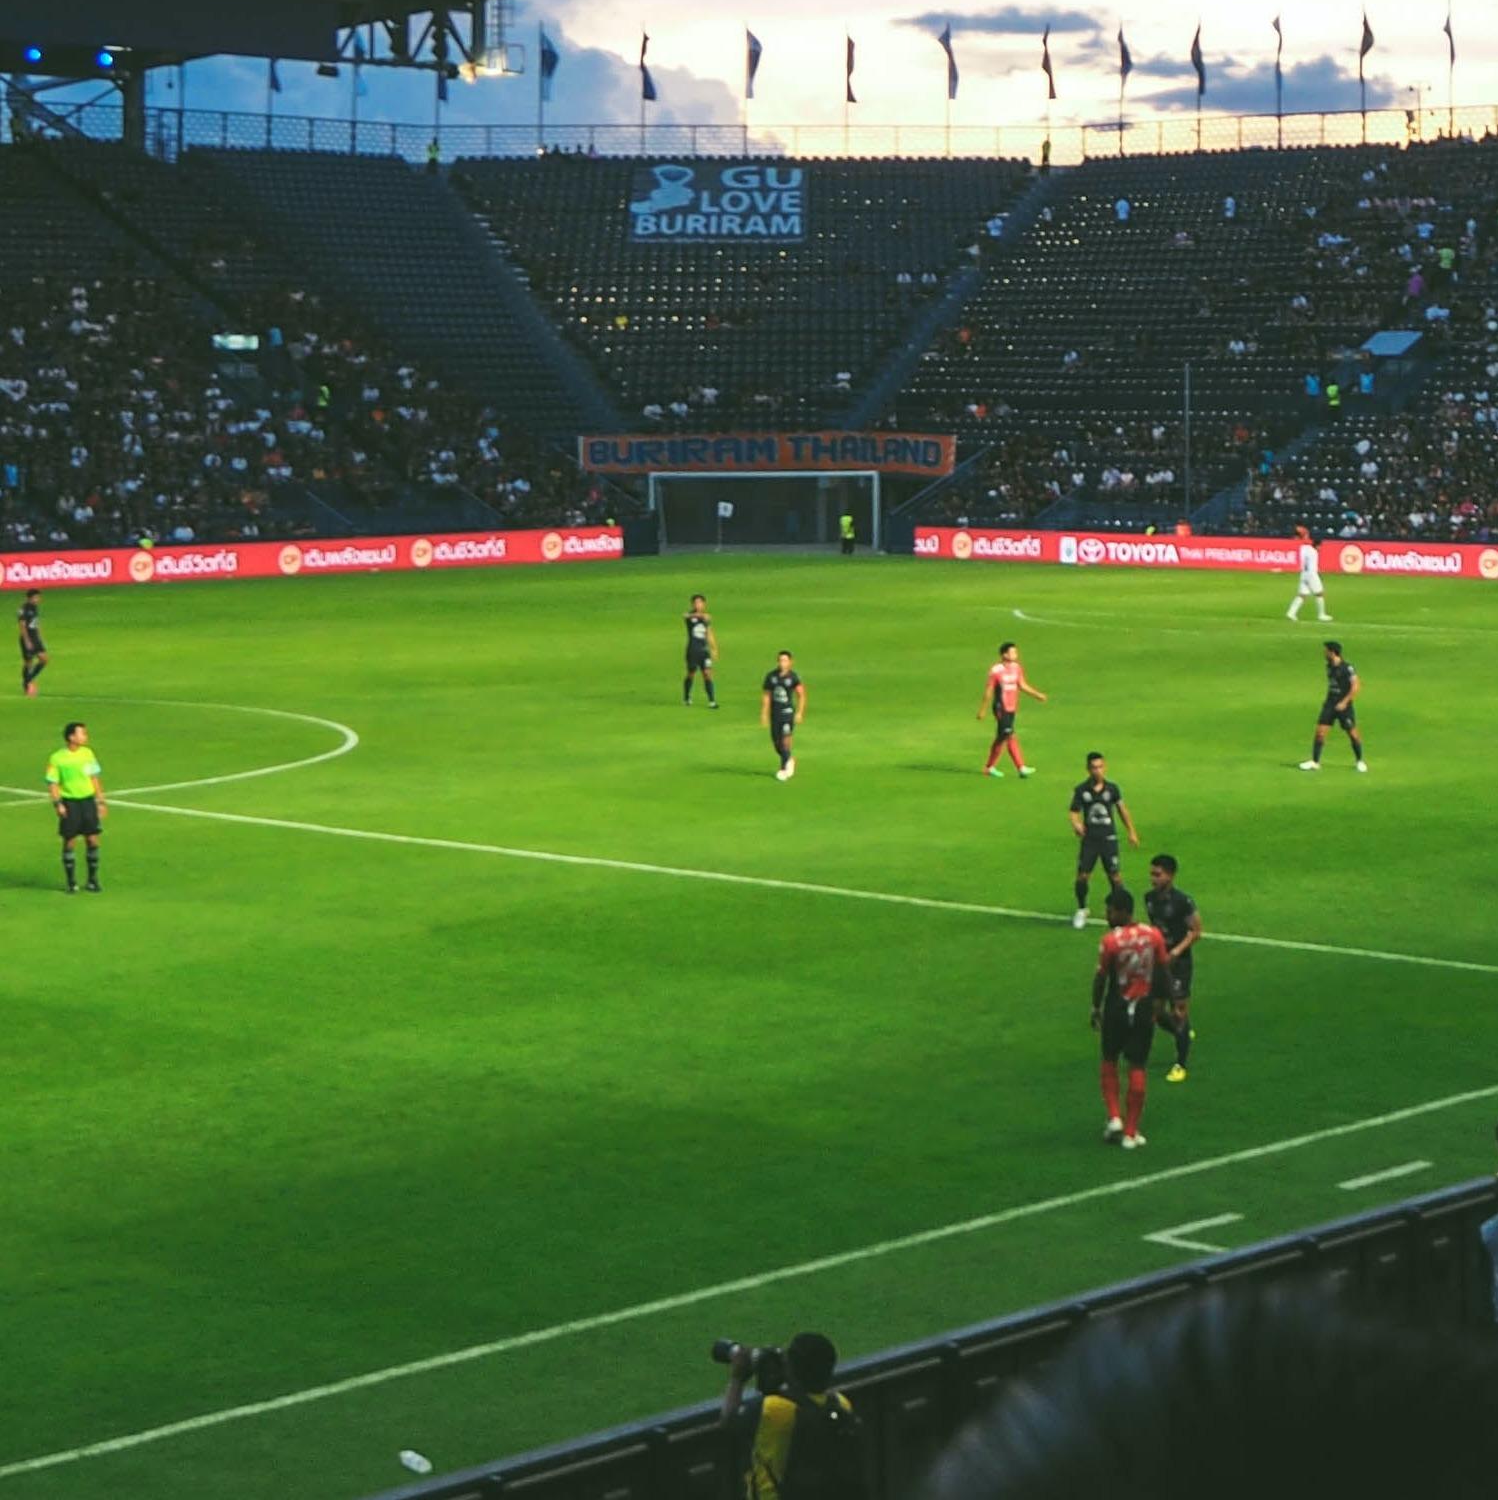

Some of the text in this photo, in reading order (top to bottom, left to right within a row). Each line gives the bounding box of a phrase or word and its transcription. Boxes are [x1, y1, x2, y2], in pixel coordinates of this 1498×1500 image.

[721, 166, 803, 189] GU
[701, 190, 802, 213] LOVE
[635, 214, 801, 236] BURIRAM
[589, 435, 942, 468] BURIRAM THAILAND
[1106, 542, 1180, 563] TOYOTA
[1254, 549, 1297, 565] LEAGUE
